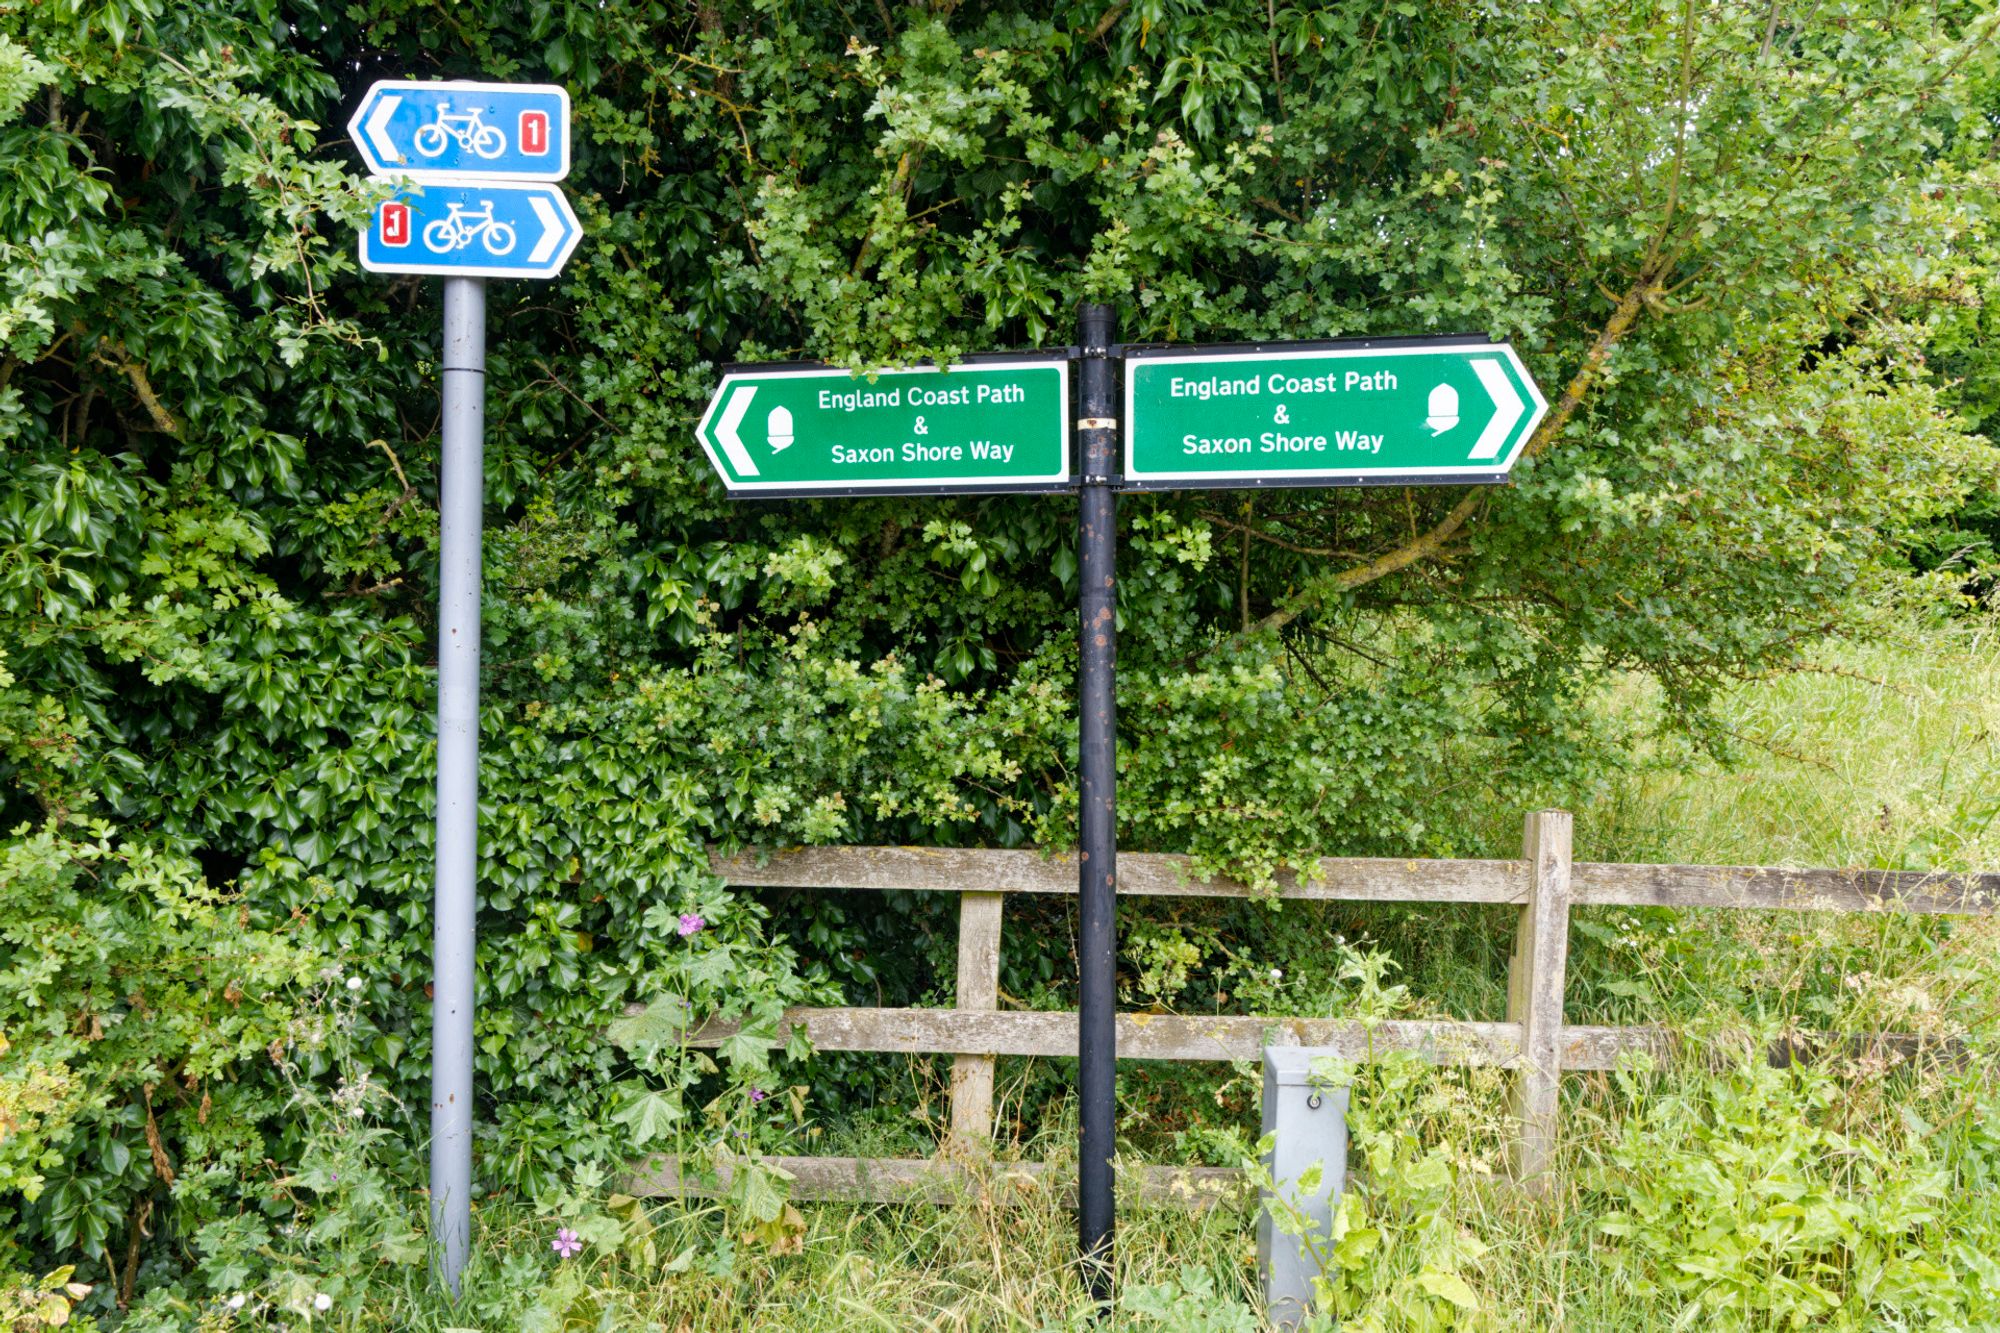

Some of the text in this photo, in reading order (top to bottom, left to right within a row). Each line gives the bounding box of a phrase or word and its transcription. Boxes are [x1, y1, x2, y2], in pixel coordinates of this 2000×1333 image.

[527, 119, 539, 146] 1
[818, 382, 1025, 411] England Coast Path
[1170, 370, 1398, 401] England Coast Path
[913, 415, 929, 435] &
[1273, 403, 1290, 425] &
[831, 440, 1015, 464] Saxon Shore Way
[1182, 430, 1385, 455] Saxon Shore Way
